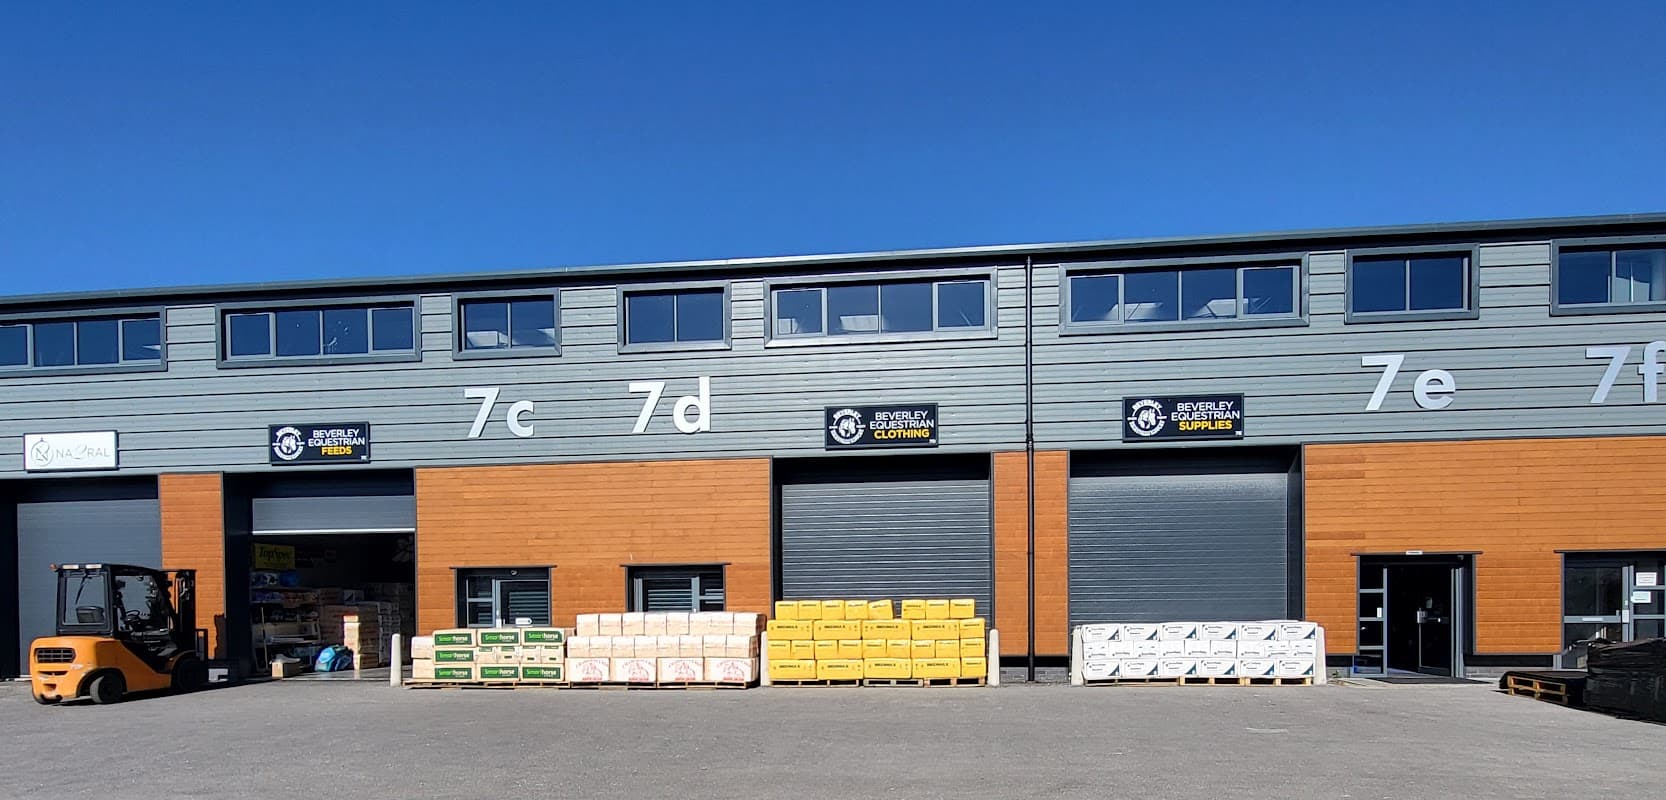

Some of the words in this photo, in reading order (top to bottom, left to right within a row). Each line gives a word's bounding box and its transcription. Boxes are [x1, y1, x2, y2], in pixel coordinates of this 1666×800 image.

[1585, 340, 1666, 404] 7f
[1361, 353, 1456, 411] 7e
[629, 376, 711, 435] 7d
[1177, 401, 1234, 412] BEVERLEY
[464, 386, 535, 439] 7c
[875, 411, 929, 421] BEVERLEY
[1171, 411, 1240, 422] EQUESTRIAN
[869, 419, 935, 430] EQUESTRIAN
[1179, 420, 1233, 431] SUPPLIES
[312, 428, 360, 439] BEVERLEY
[874, 429, 930, 439] CLOTHING
[308, 437, 366, 447] EQUESTRIAN
[321, 446, 352, 456] FEEDS
